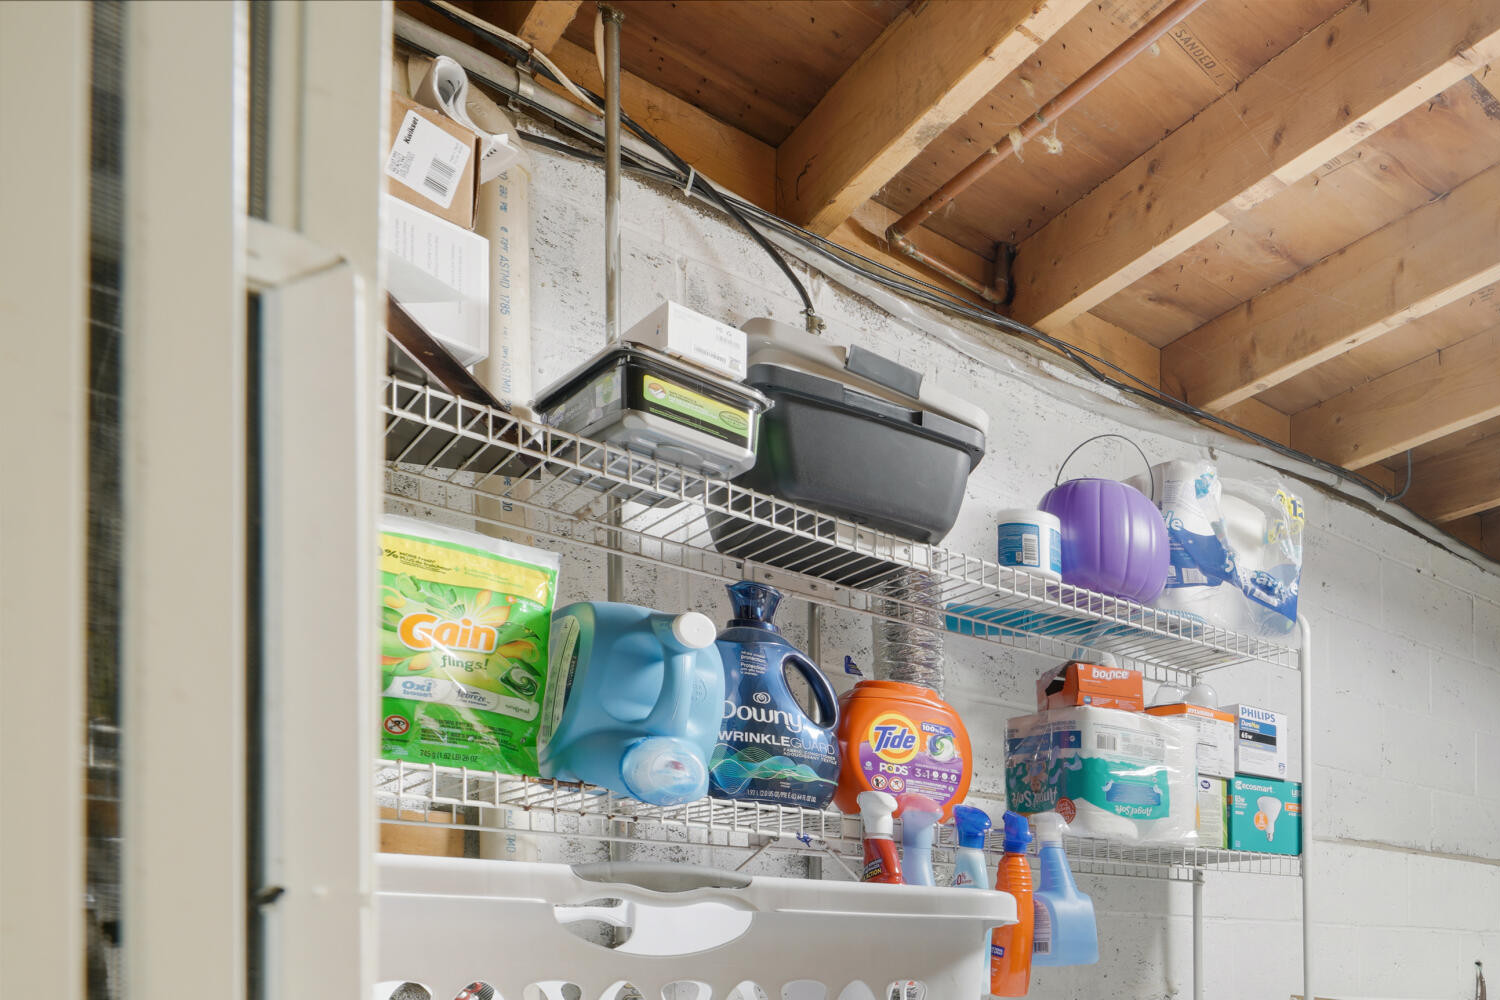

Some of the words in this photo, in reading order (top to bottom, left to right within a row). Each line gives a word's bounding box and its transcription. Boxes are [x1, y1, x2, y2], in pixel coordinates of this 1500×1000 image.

[1175, 28, 1207, 70] SANDED
[403, 116, 419, 144] Kwikset
[399, 612, 497, 653] Gain
[440, 655, 489, 672] flings!
[1091, 667, 1130, 680] bounce
[401, 680, 433, 692] Oxi
[722, 700, 803, 733] Downy
[1240, 706, 1276, 723] PHILIPS
[873, 725, 917, 754] Tide
[879, 762, 909, 776] PODS
[1242, 781, 1274, 793] ecosmart
[1129, 805, 1153, 817] Angel
